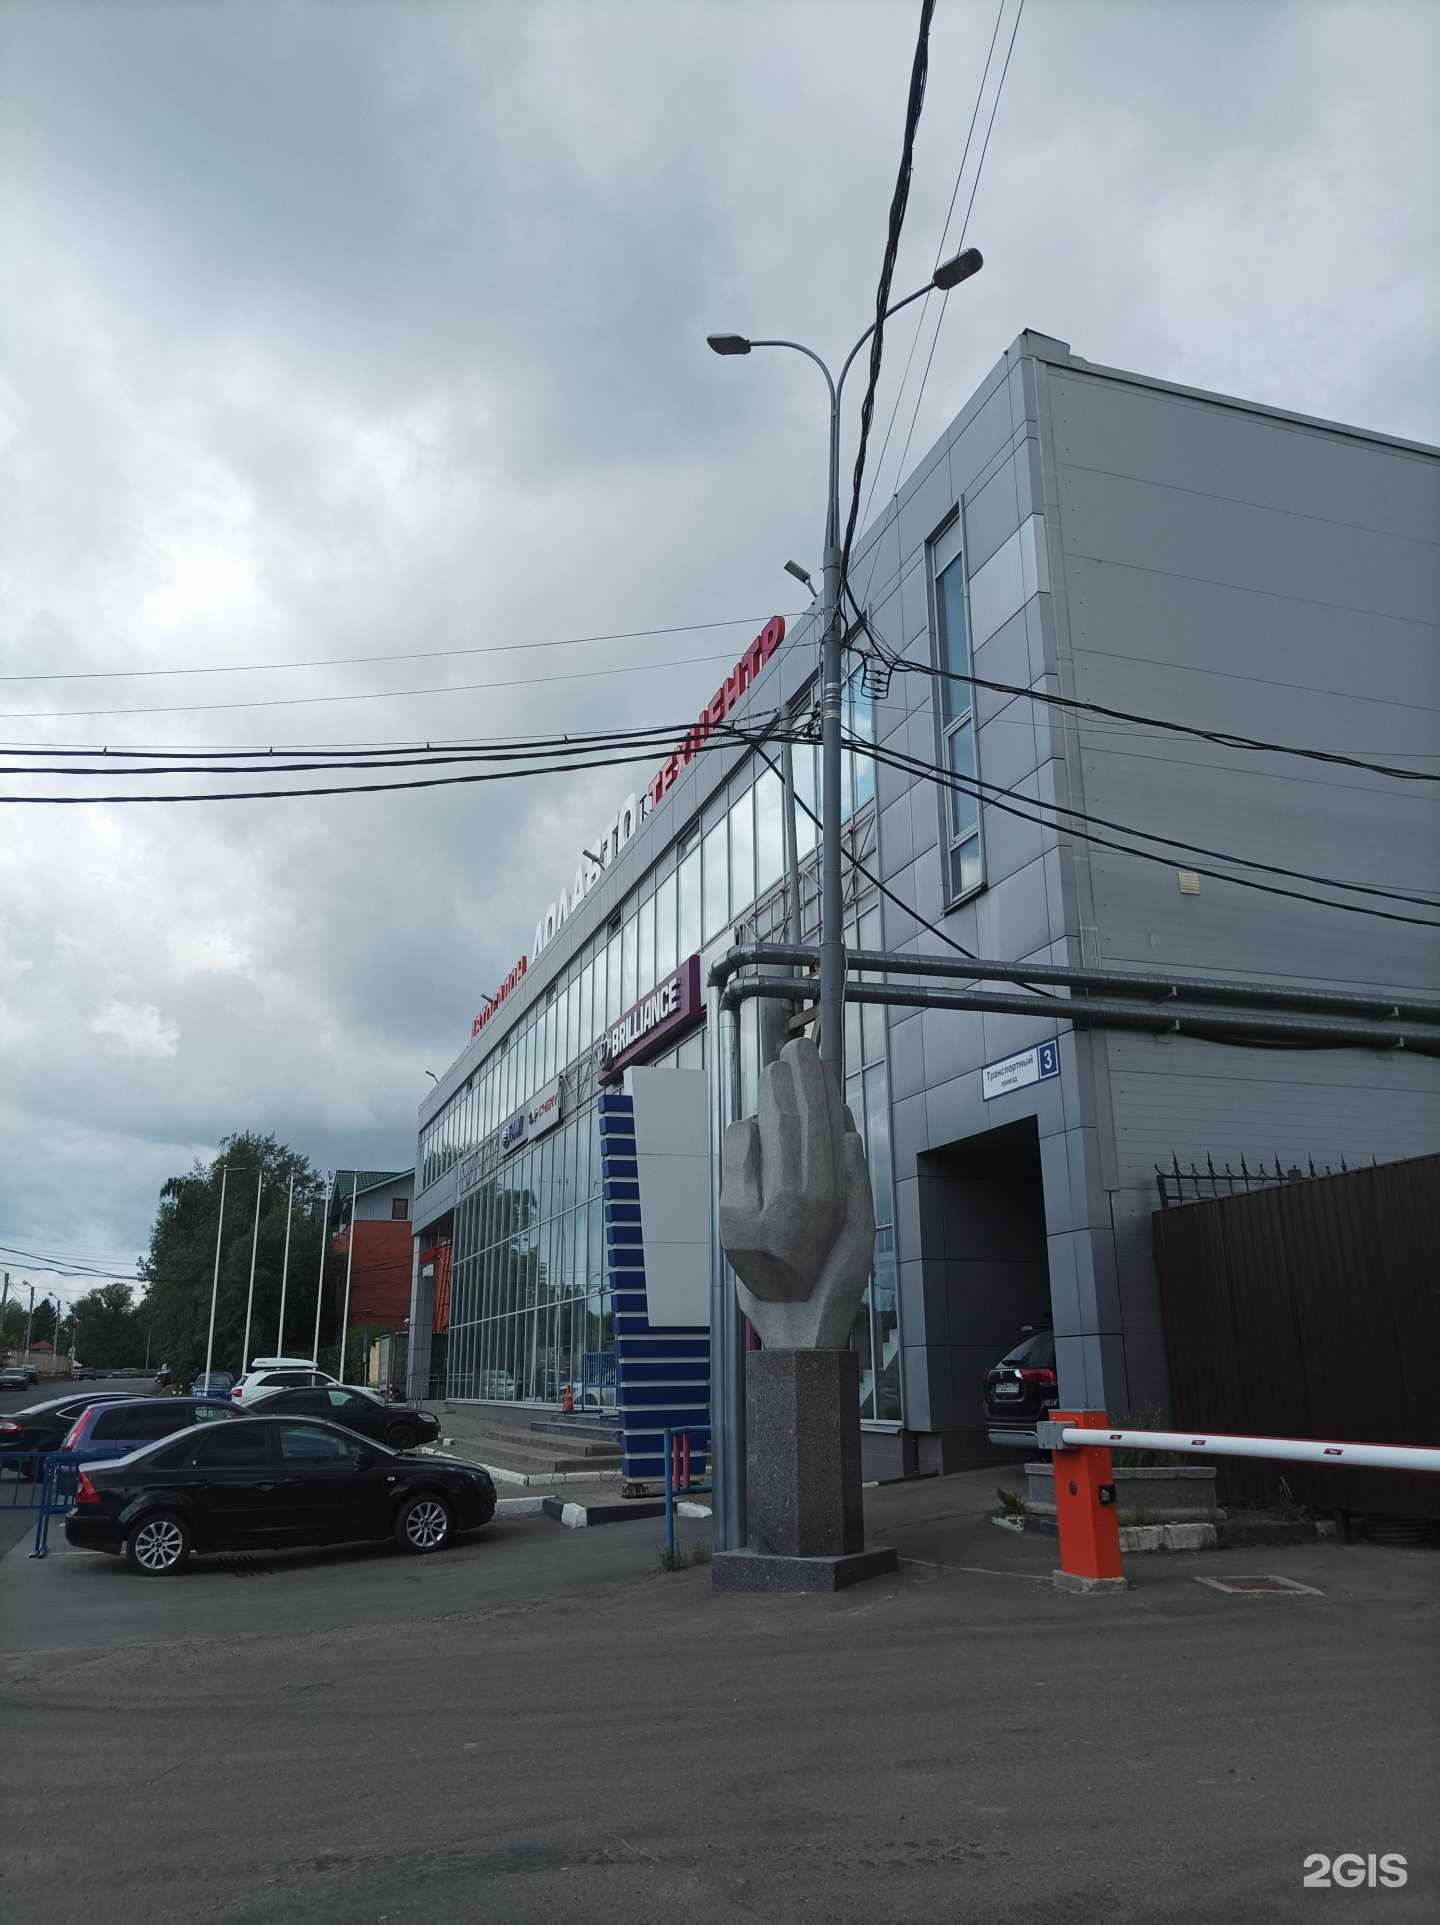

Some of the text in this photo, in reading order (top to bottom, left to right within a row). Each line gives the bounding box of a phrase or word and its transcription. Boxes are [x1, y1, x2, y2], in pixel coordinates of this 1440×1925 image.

[612, 977, 679, 1058] BRILLIANCE
[986, 1054, 1034, 1082] Транспортный
[1043, 1049, 1053, 1070] 3
